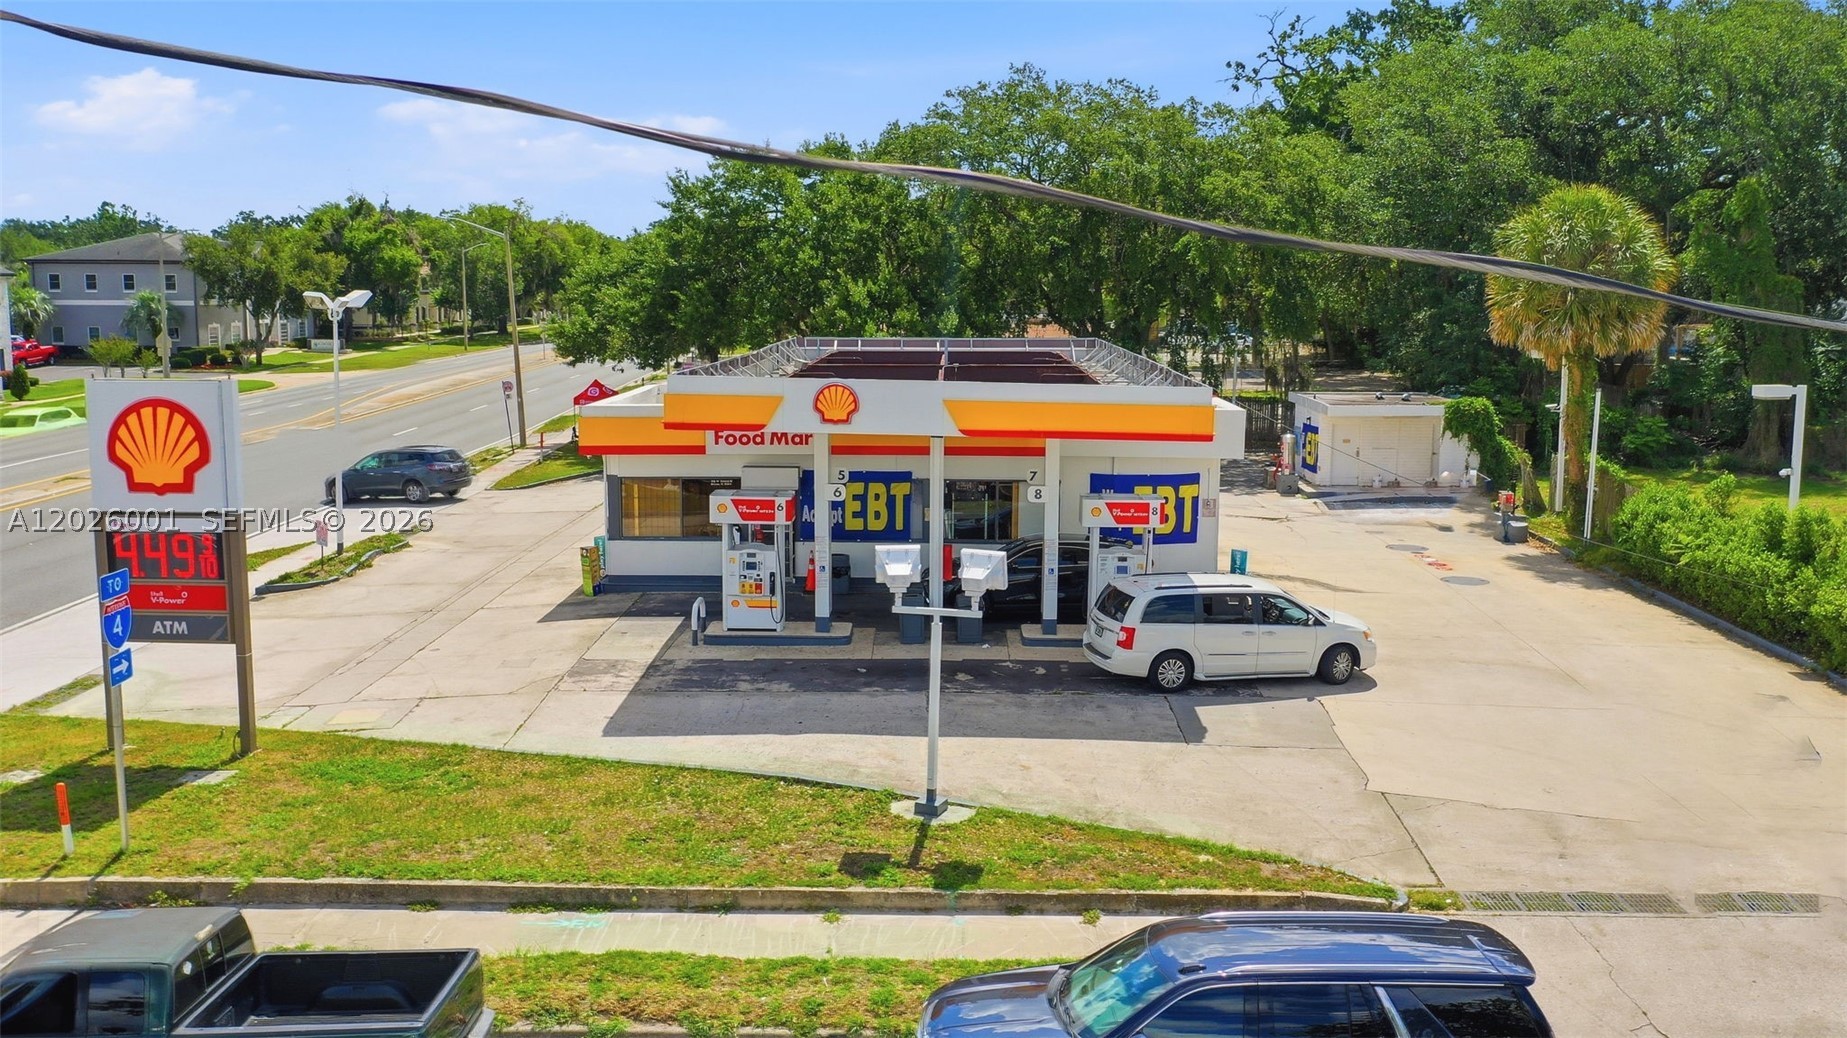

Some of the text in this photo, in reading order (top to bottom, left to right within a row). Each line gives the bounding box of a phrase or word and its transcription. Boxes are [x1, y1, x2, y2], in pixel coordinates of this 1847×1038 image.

[714, 431, 813, 446] Food Mar
[838, 470, 846, 480] 5
[1029, 471, 1038, 481] 7
[833, 487, 842, 498] 6
[1034, 488, 1043, 500] 8
[776, 503, 784, 512] 6
[844, 482, 911, 531] EBT
[1151, 507, 1158, 516] 8
[106, 577, 122, 594] TO
[113, 614, 123, 637] 4
[152, 620, 189, 635] ATM
